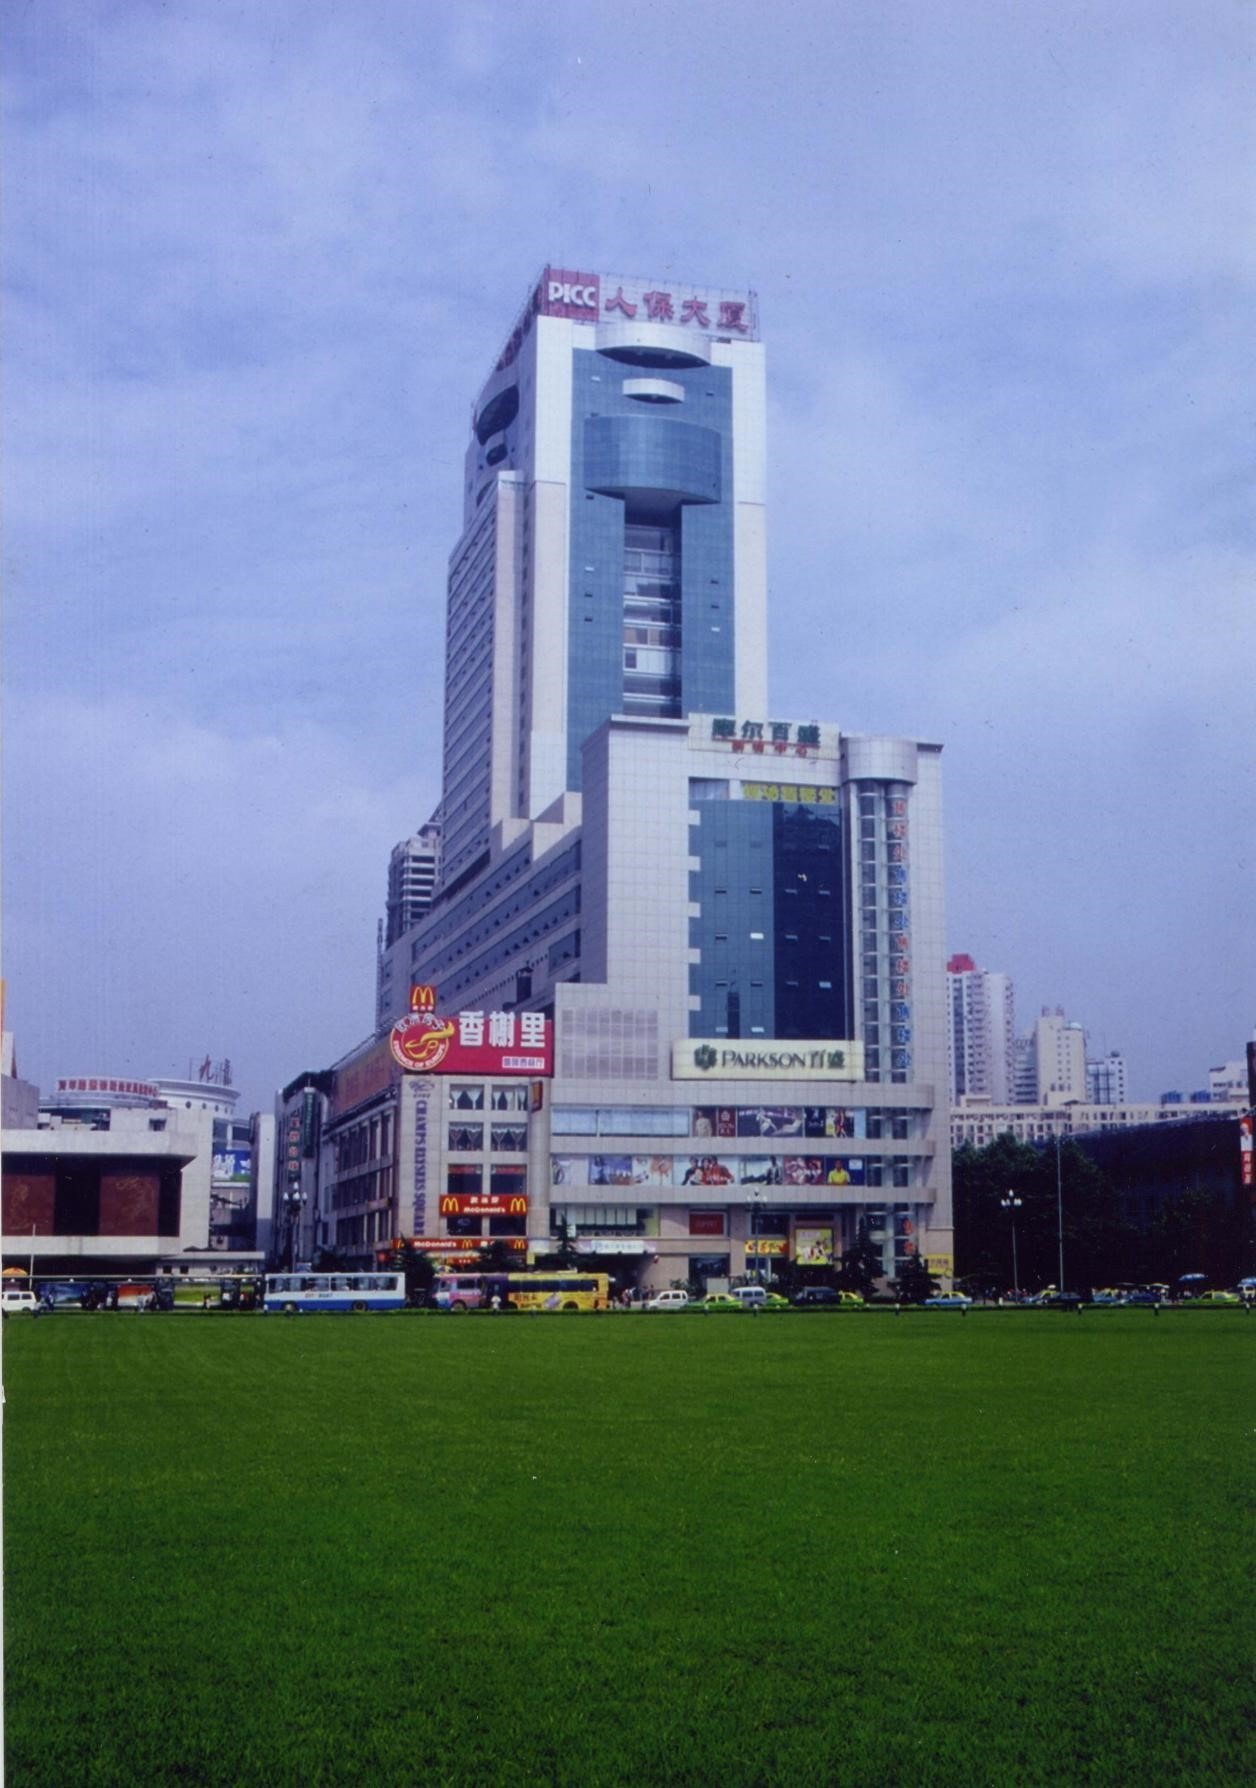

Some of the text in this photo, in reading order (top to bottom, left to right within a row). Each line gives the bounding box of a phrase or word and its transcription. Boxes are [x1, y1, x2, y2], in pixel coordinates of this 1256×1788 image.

[548, 281, 597, 308] PICC
[459, 1010, 546, 1048] 香榭里
[722, 1050, 806, 1069] PARKSON
[414, 1240, 457, 1248] McDonald's
